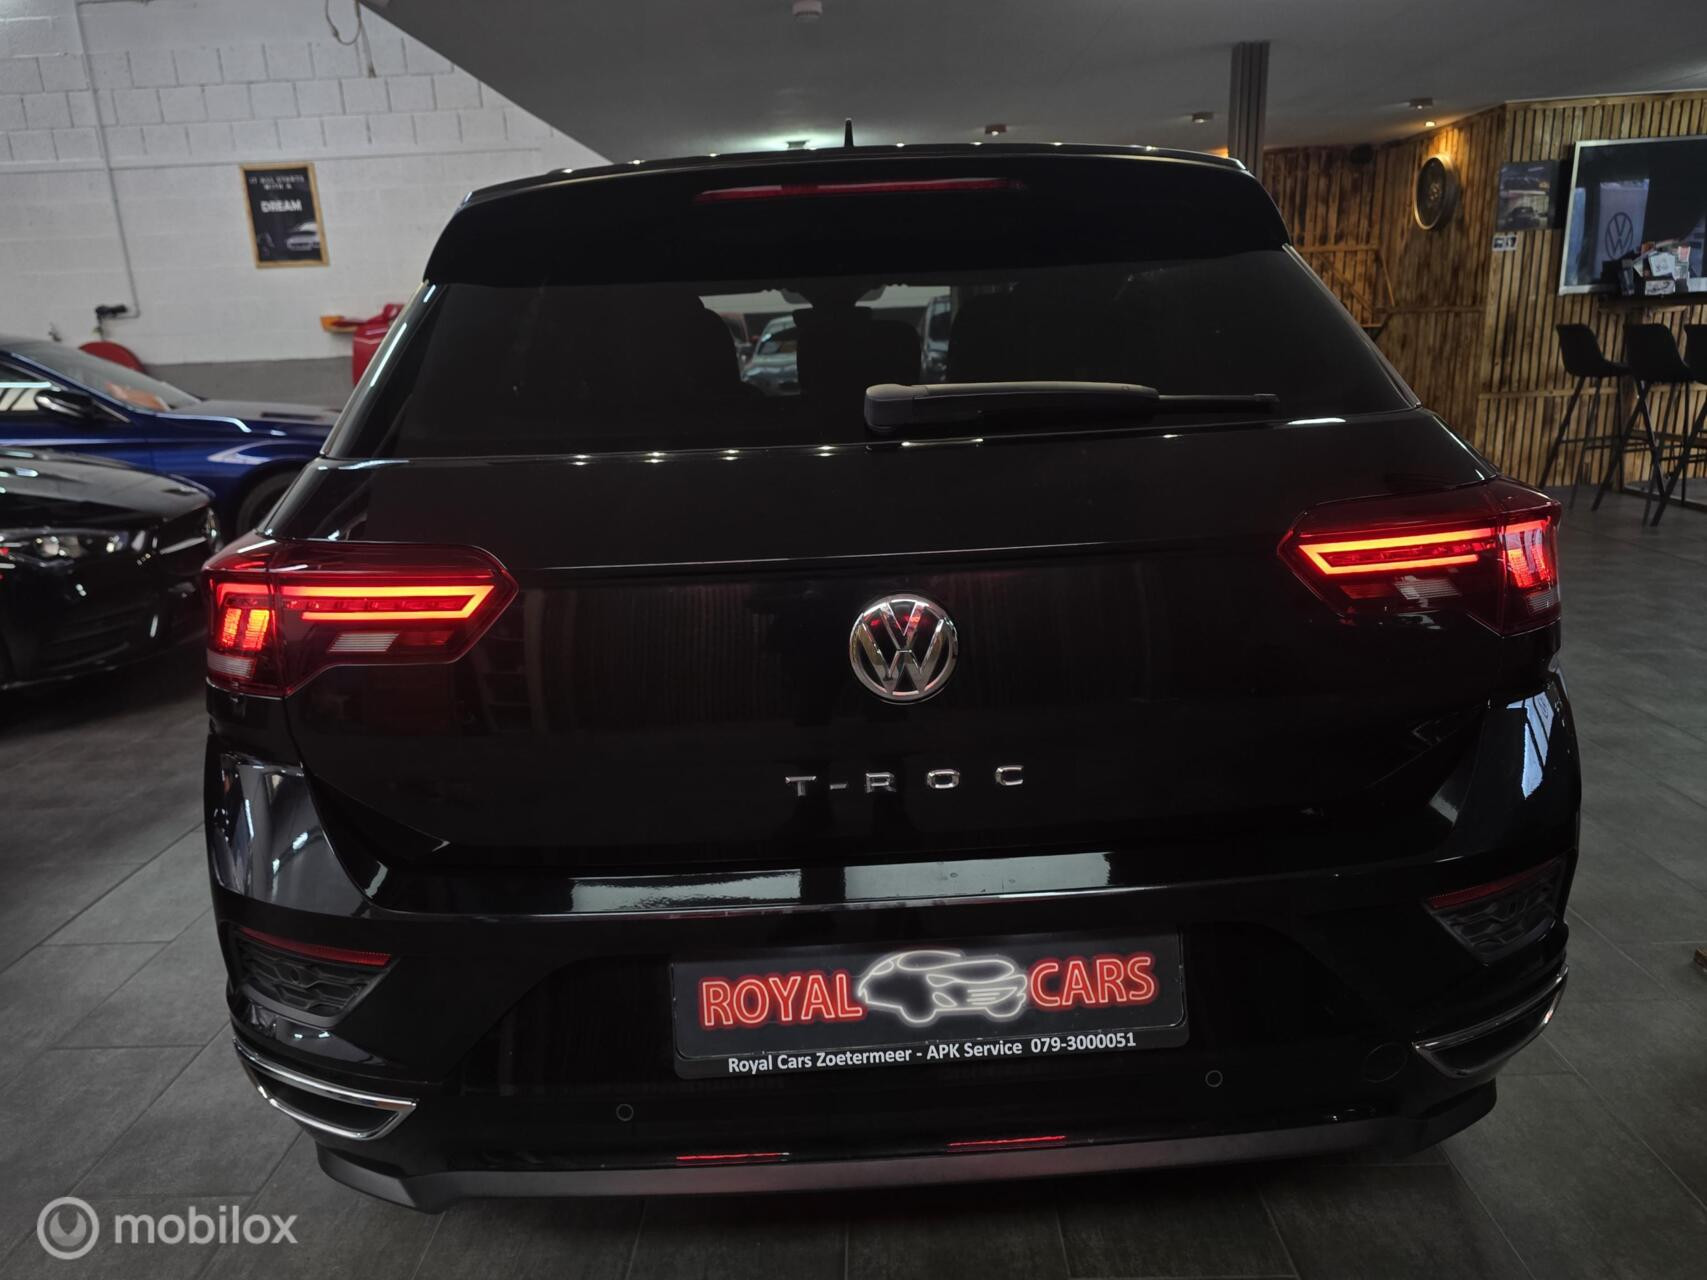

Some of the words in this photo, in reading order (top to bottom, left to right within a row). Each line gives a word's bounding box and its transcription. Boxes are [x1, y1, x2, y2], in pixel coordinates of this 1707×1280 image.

[260, 199, 302, 213] DREAM
[850, 594, 958, 704] VW
[701, 972, 863, 1027] ROYAL
[1031, 956, 1155, 1007] CARS
[728, 1055, 773, 1075] Royal
[777, 1053, 812, 1069] Cars
[816, 1049, 912, 1067] Zoetermeer
[926, 1043, 960, 1060] APK
[964, 1040, 1022, 1058] Service
[1031, 1032, 1136, 1053] 079-3000051
